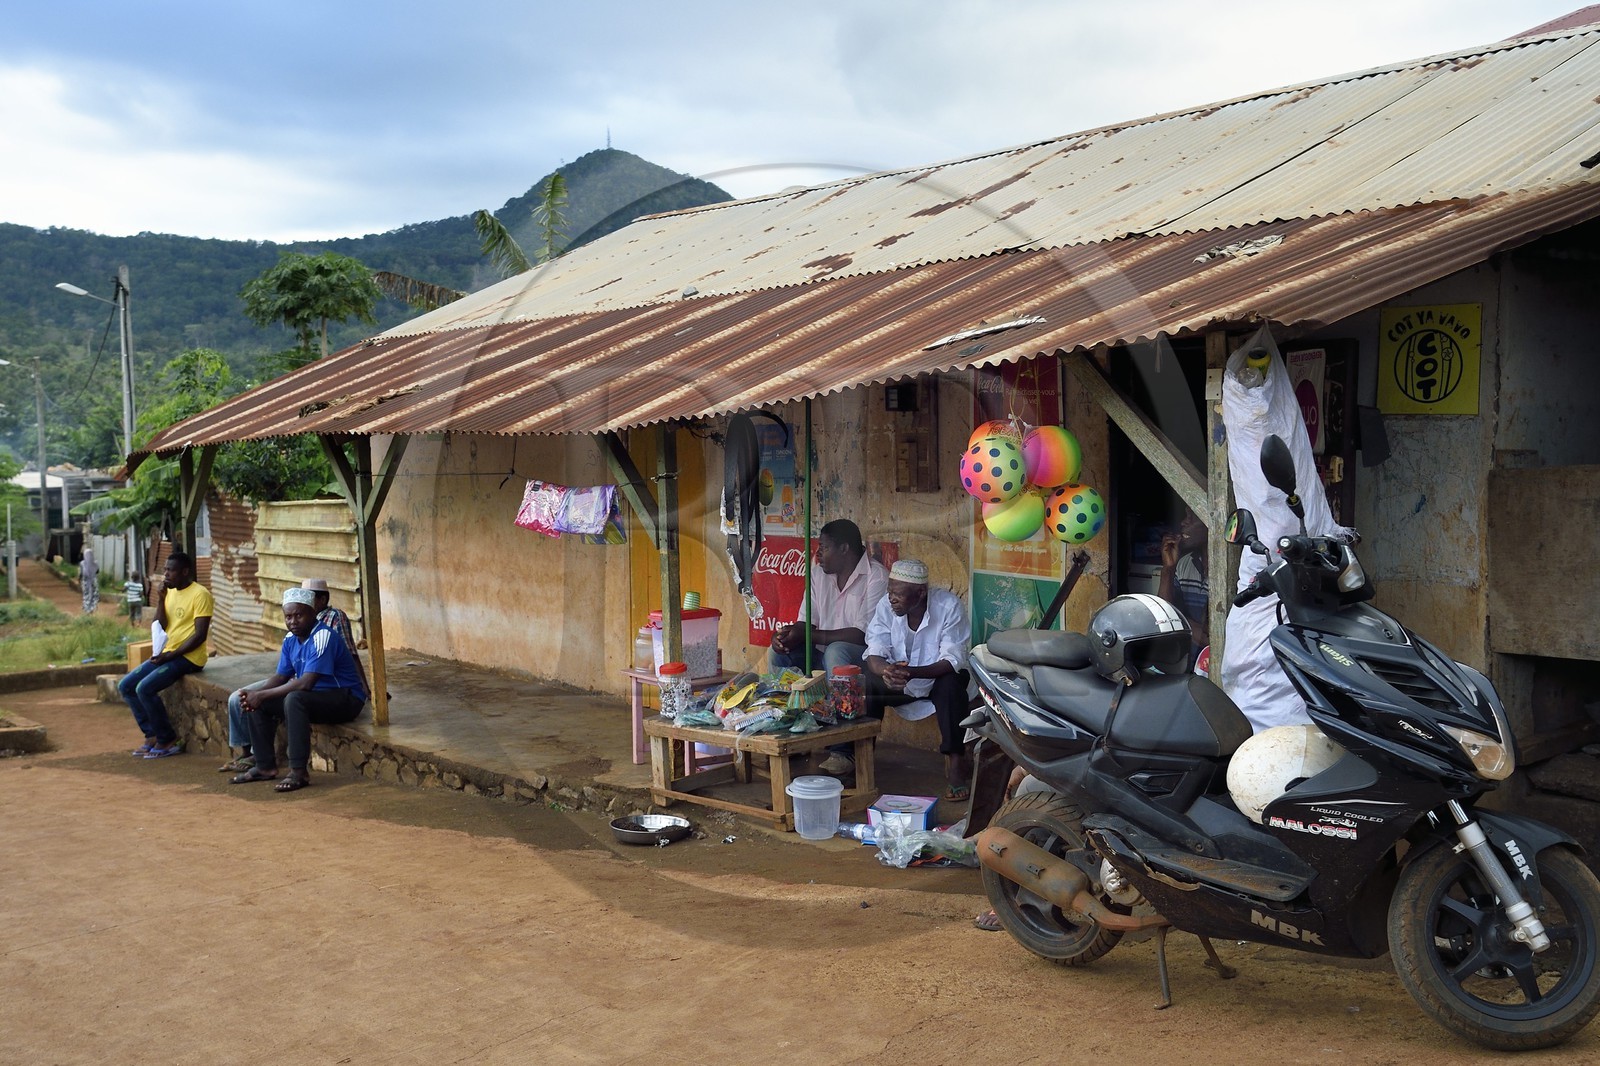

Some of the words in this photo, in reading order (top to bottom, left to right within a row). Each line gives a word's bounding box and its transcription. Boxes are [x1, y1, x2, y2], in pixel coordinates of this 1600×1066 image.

[1388, 314, 1414, 342] COT
[1416, 310, 1434, 325] YA
[1416, 333, 1438, 400] COT
[753, 547, 806, 577] Coca-Cola
[1269, 816, 1358, 840] MALOSSI
[1310, 806, 1342, 816] LIQUID
[1344, 812, 1384, 823] COOLED
[1504, 839, 1534, 881] MBK
[1250, 909, 1326, 947] MBK
